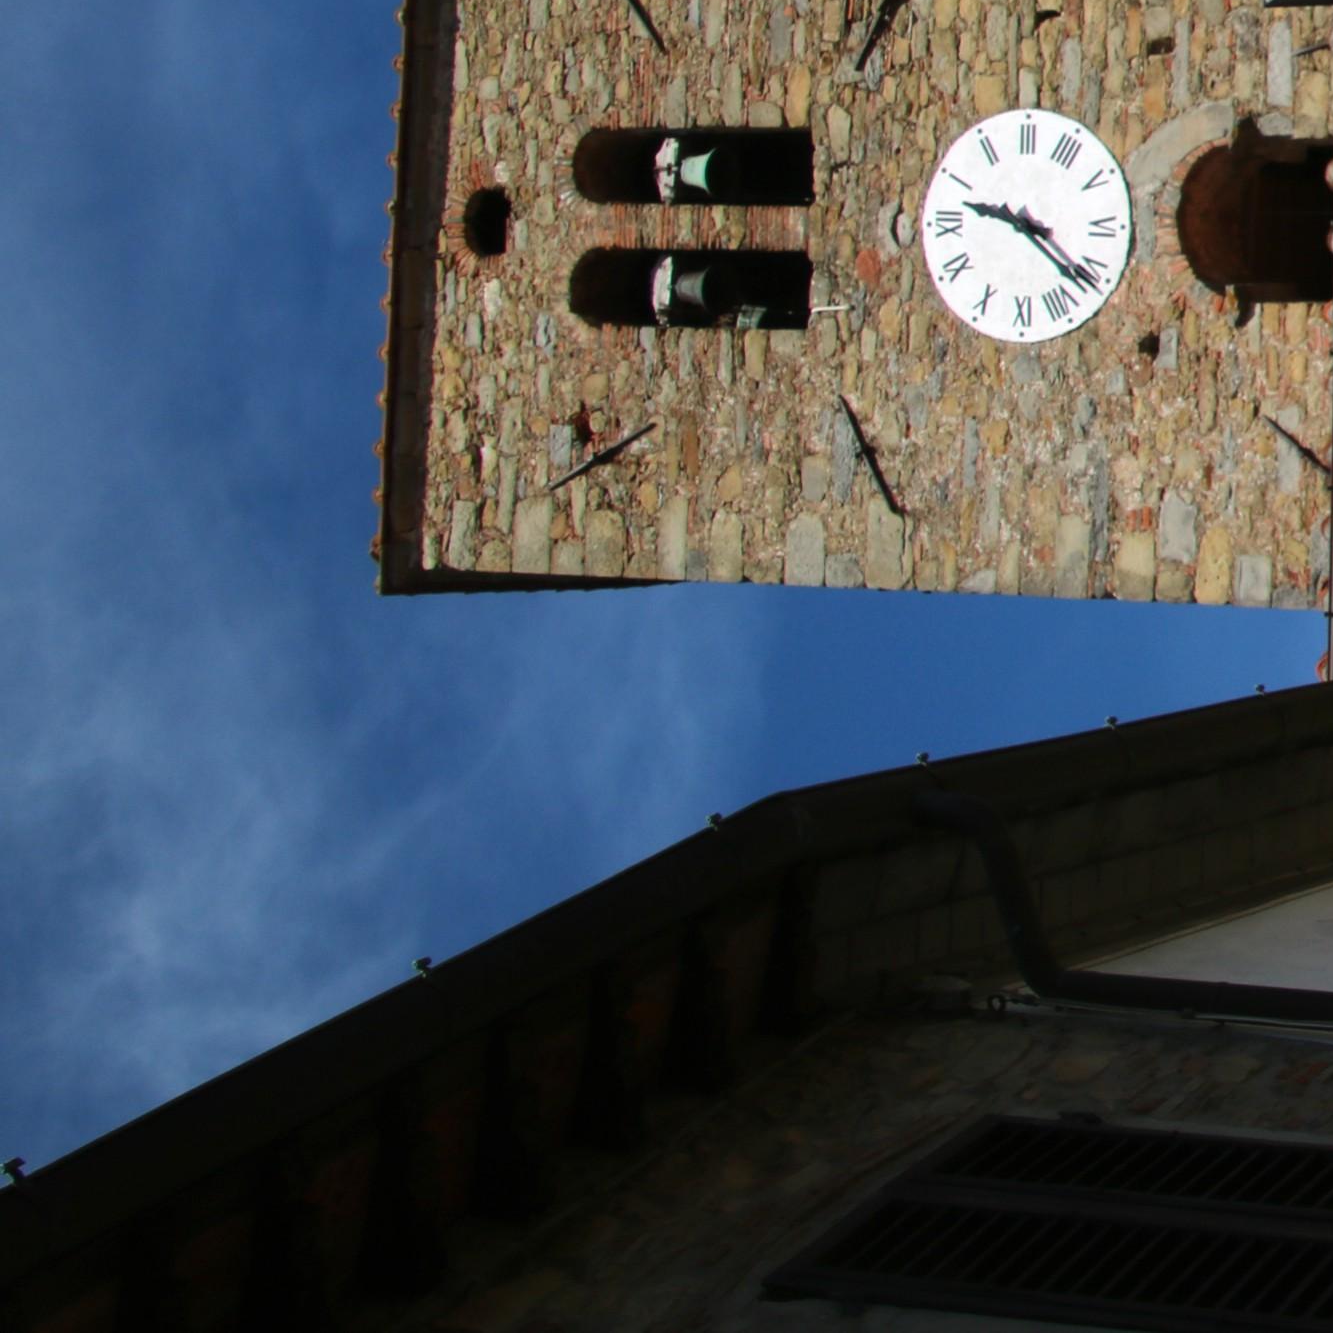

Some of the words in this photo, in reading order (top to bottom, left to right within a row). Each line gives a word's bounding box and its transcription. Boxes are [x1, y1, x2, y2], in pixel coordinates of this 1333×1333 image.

[979, 136, 999, 166] II
[1020, 124, 1036, 154] III
[1051, 133, 1082, 169] IIII
[949, 173, 972, 190] I
[1082, 169, 1108, 190] V
[936, 211, 963, 237] XII
[1088, 217, 1116, 237] VI
[942, 252, 973, 282] XI
[973, 284, 996, 315] X
[1013, 296, 1031, 327] IX
[1042, 285, 1080, 321] VIII
